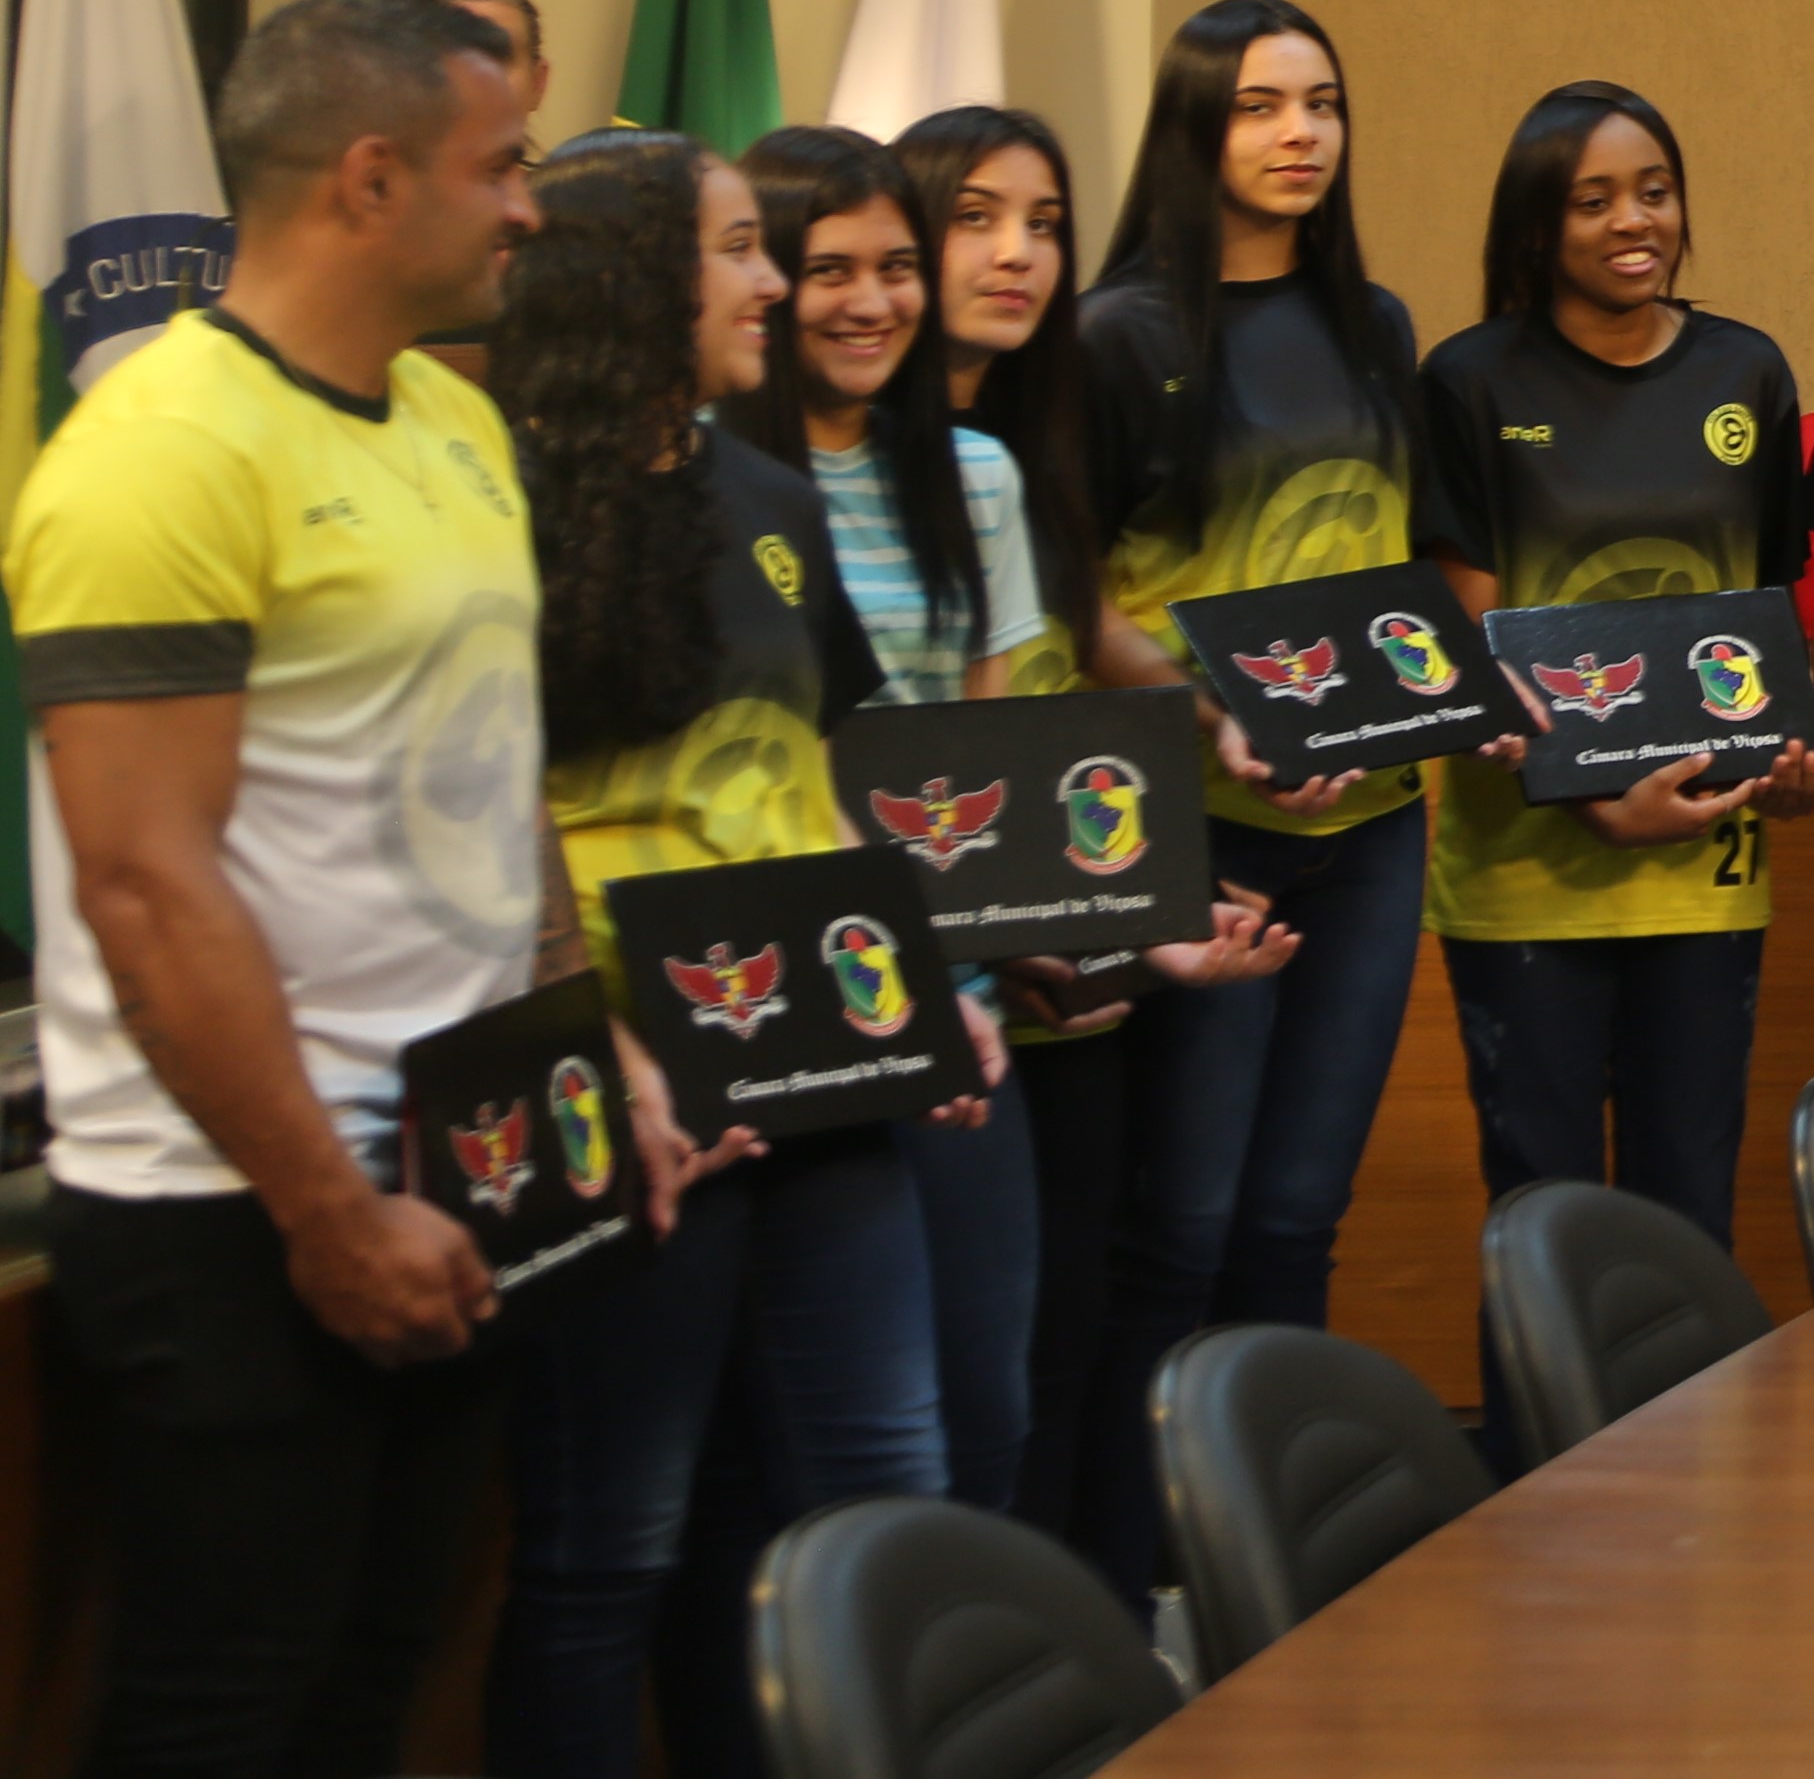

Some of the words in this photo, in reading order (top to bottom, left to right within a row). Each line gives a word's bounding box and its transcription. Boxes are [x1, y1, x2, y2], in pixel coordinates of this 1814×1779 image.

[88, 245, 230, 301] CULTU
[1637, 740, 1710, 760] Municipal
[1711, 737, 1729, 751] de
[1731, 732, 1784, 749] Viçosa
[929, 910, 976, 928] mara
[978, 900, 1066, 925] Municipal
[1069, 898, 1090, 914] de
